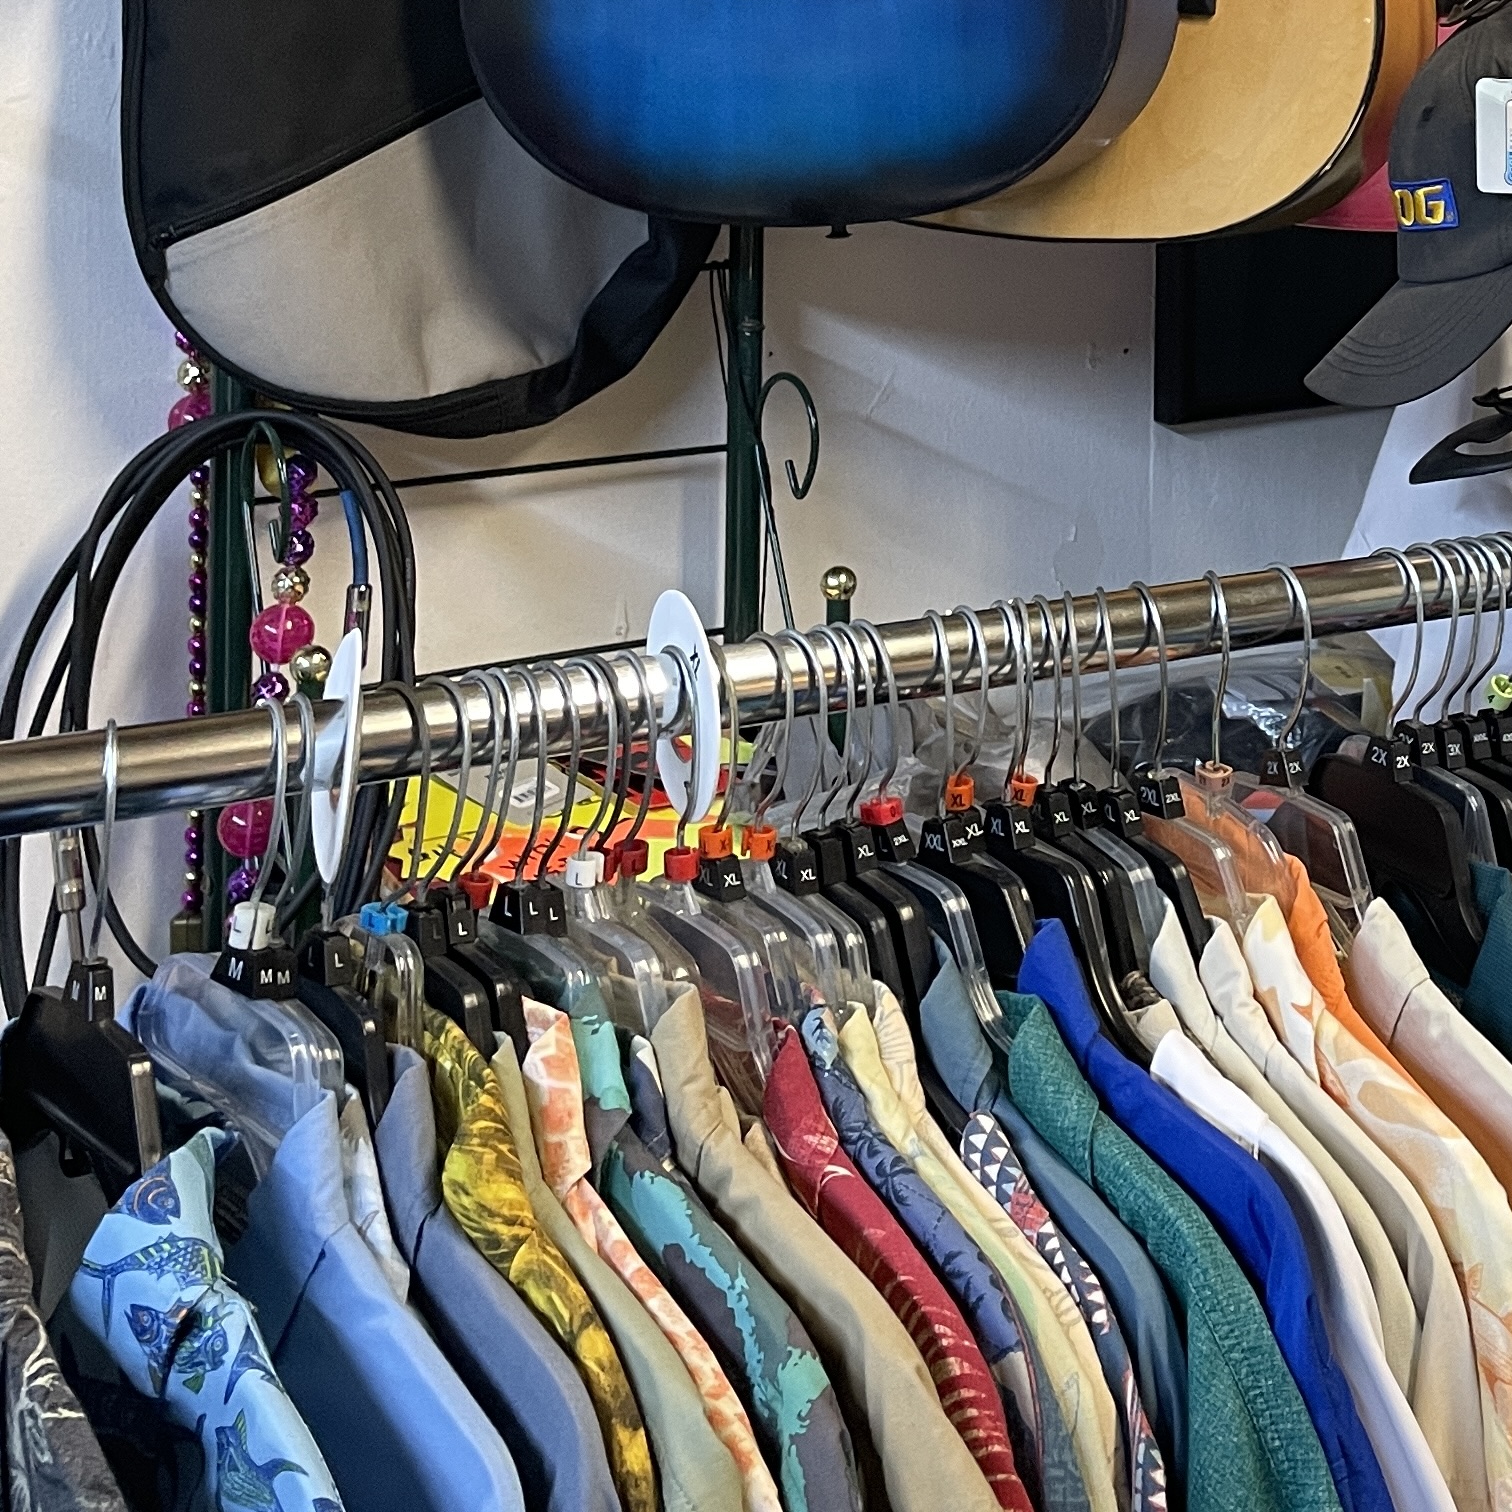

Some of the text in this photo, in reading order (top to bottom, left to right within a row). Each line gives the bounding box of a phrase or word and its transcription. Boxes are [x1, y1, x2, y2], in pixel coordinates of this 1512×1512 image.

[1421, 742, 1436, 755] 2X
[1447, 743, 1462, 757] 3X
[1371, 746, 1388, 767] 2X
[1396, 755, 1411, 769] 2X
[1266, 760, 1279, 775] 2X
[1288, 761, 1302, 774] 2X
[950, 793, 966, 808] XL
[1012, 788, 1026, 803] XL
[1165, 792, 1182, 805] 2XL
[1080, 800, 1098, 816] XL
[1053, 811, 1070, 824] XL
[1123, 809, 1141, 823] XL
[964, 822, 985, 840] XL
[990, 815, 1005, 837] XL
[1014, 820, 1031, 835] XL
[924, 831, 945, 852] XXL
[951, 837, 969, 849] XXL
[857, 844, 875, 859] XL
[575, 872, 583, 886] L
[723, 873, 741, 888] XL
[800, 868, 817, 882] XL
[504, 895, 513, 917] L
[528, 901, 539, 916] L
[367, 912, 376, 928] L
[549, 907, 559, 921] L
[233, 921, 242, 934] L
[457, 921, 468, 936] L
[334, 952, 344, 968] L
[228, 957, 243, 981] M
[260, 969, 273, 984] M
[276, 970, 290, 985] M
[94, 986, 107, 1001] M
